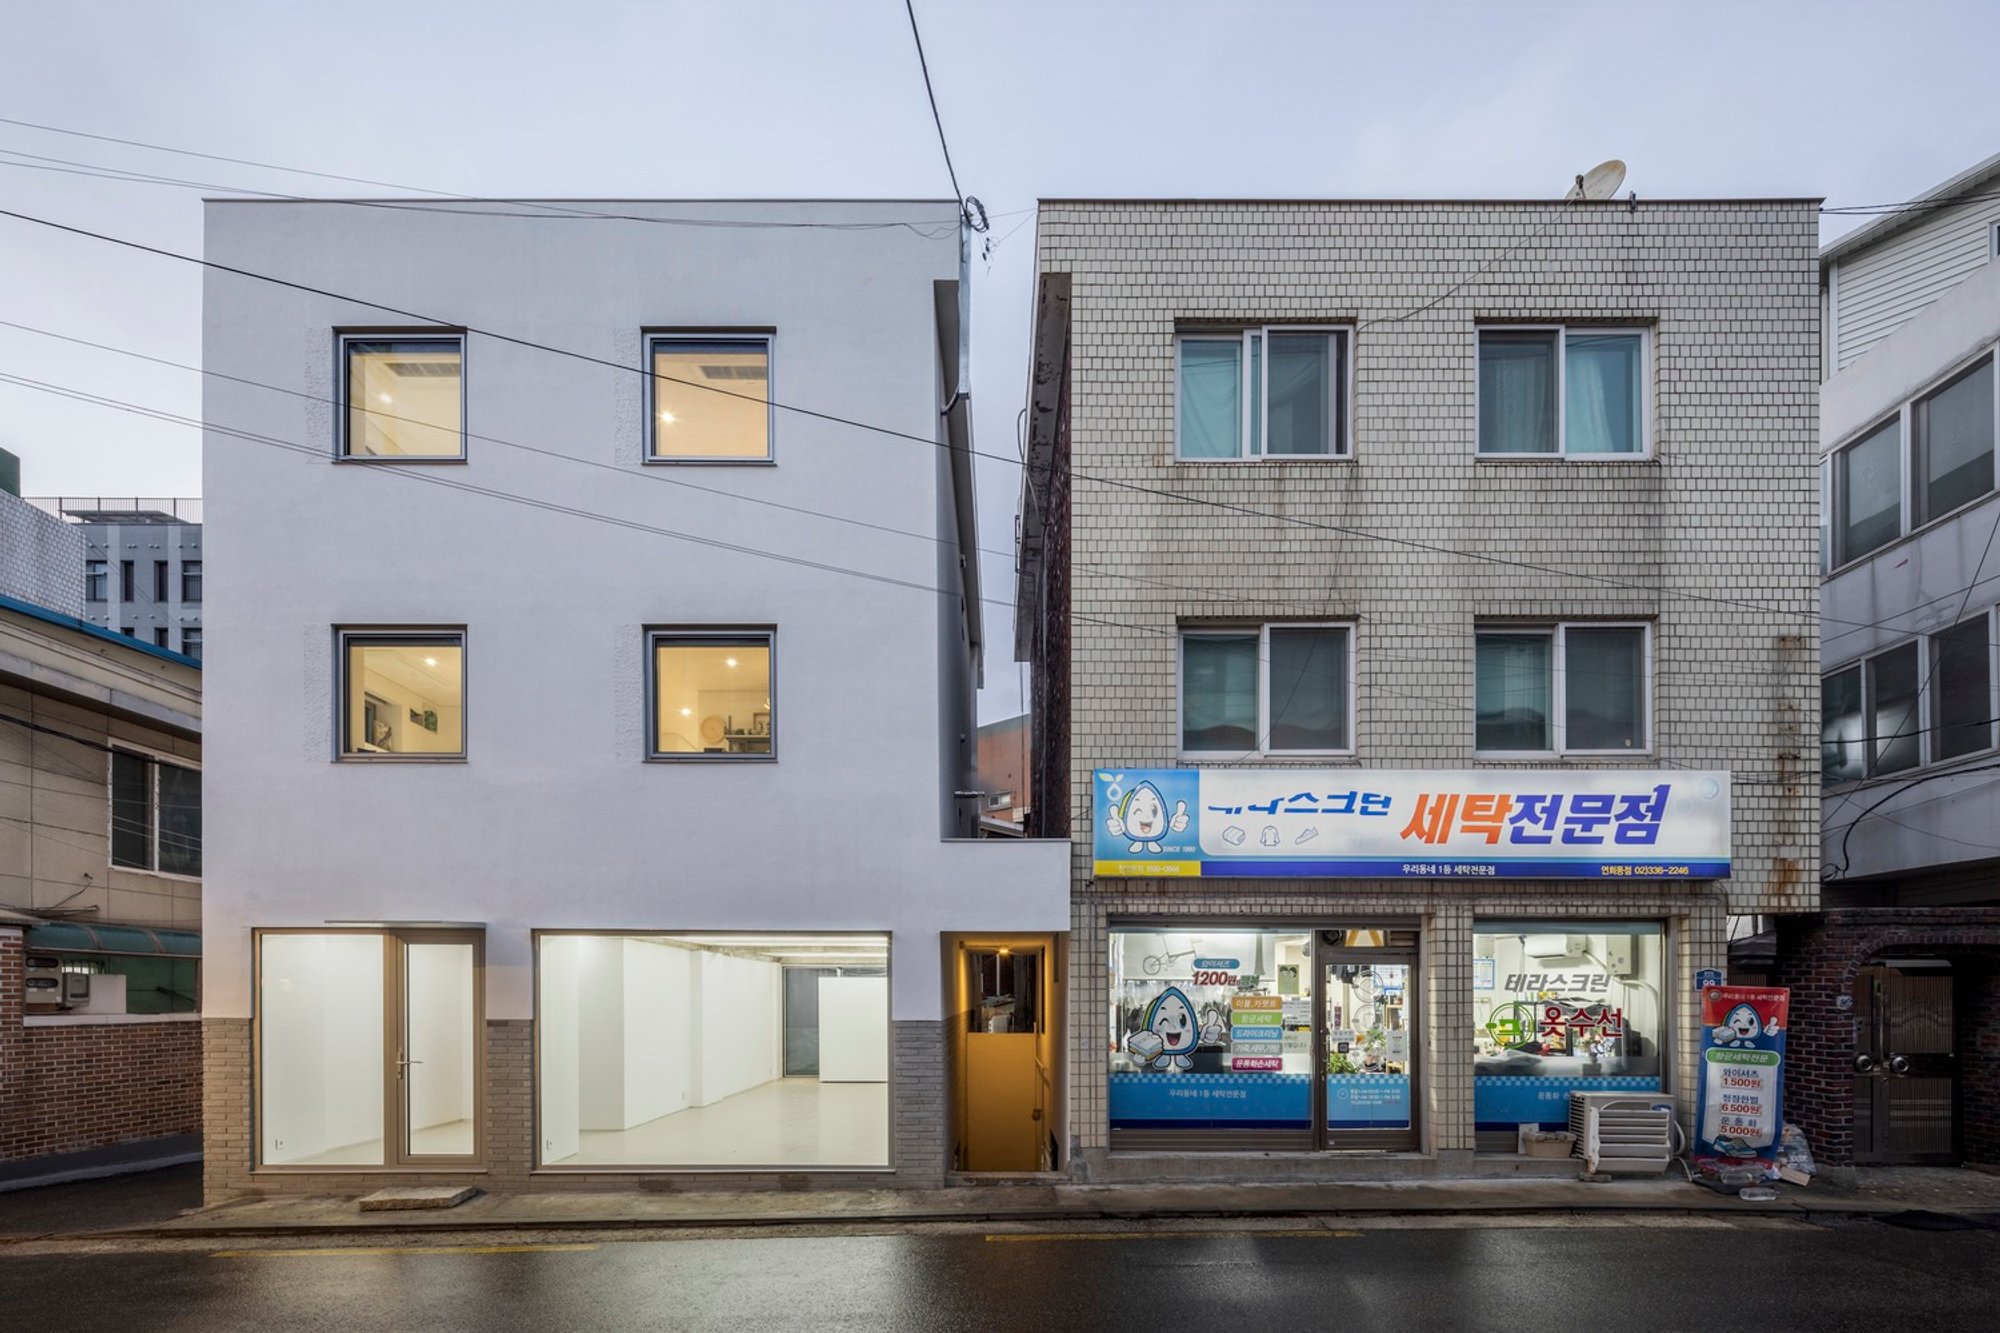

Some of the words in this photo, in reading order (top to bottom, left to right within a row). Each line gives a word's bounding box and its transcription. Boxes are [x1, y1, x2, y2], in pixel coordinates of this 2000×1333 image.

[1400, 784, 1671, 844] 세탁전문점
[1402, 864, 1436, 874] 우리동네
[1438, 865, 1451, 874] 1등
[1454, 865, 1495, 875] 세탁전문점
[1504, 974, 1611, 992] 테라스크린
[1540, 1006, 1623, 1037] 옷수선
